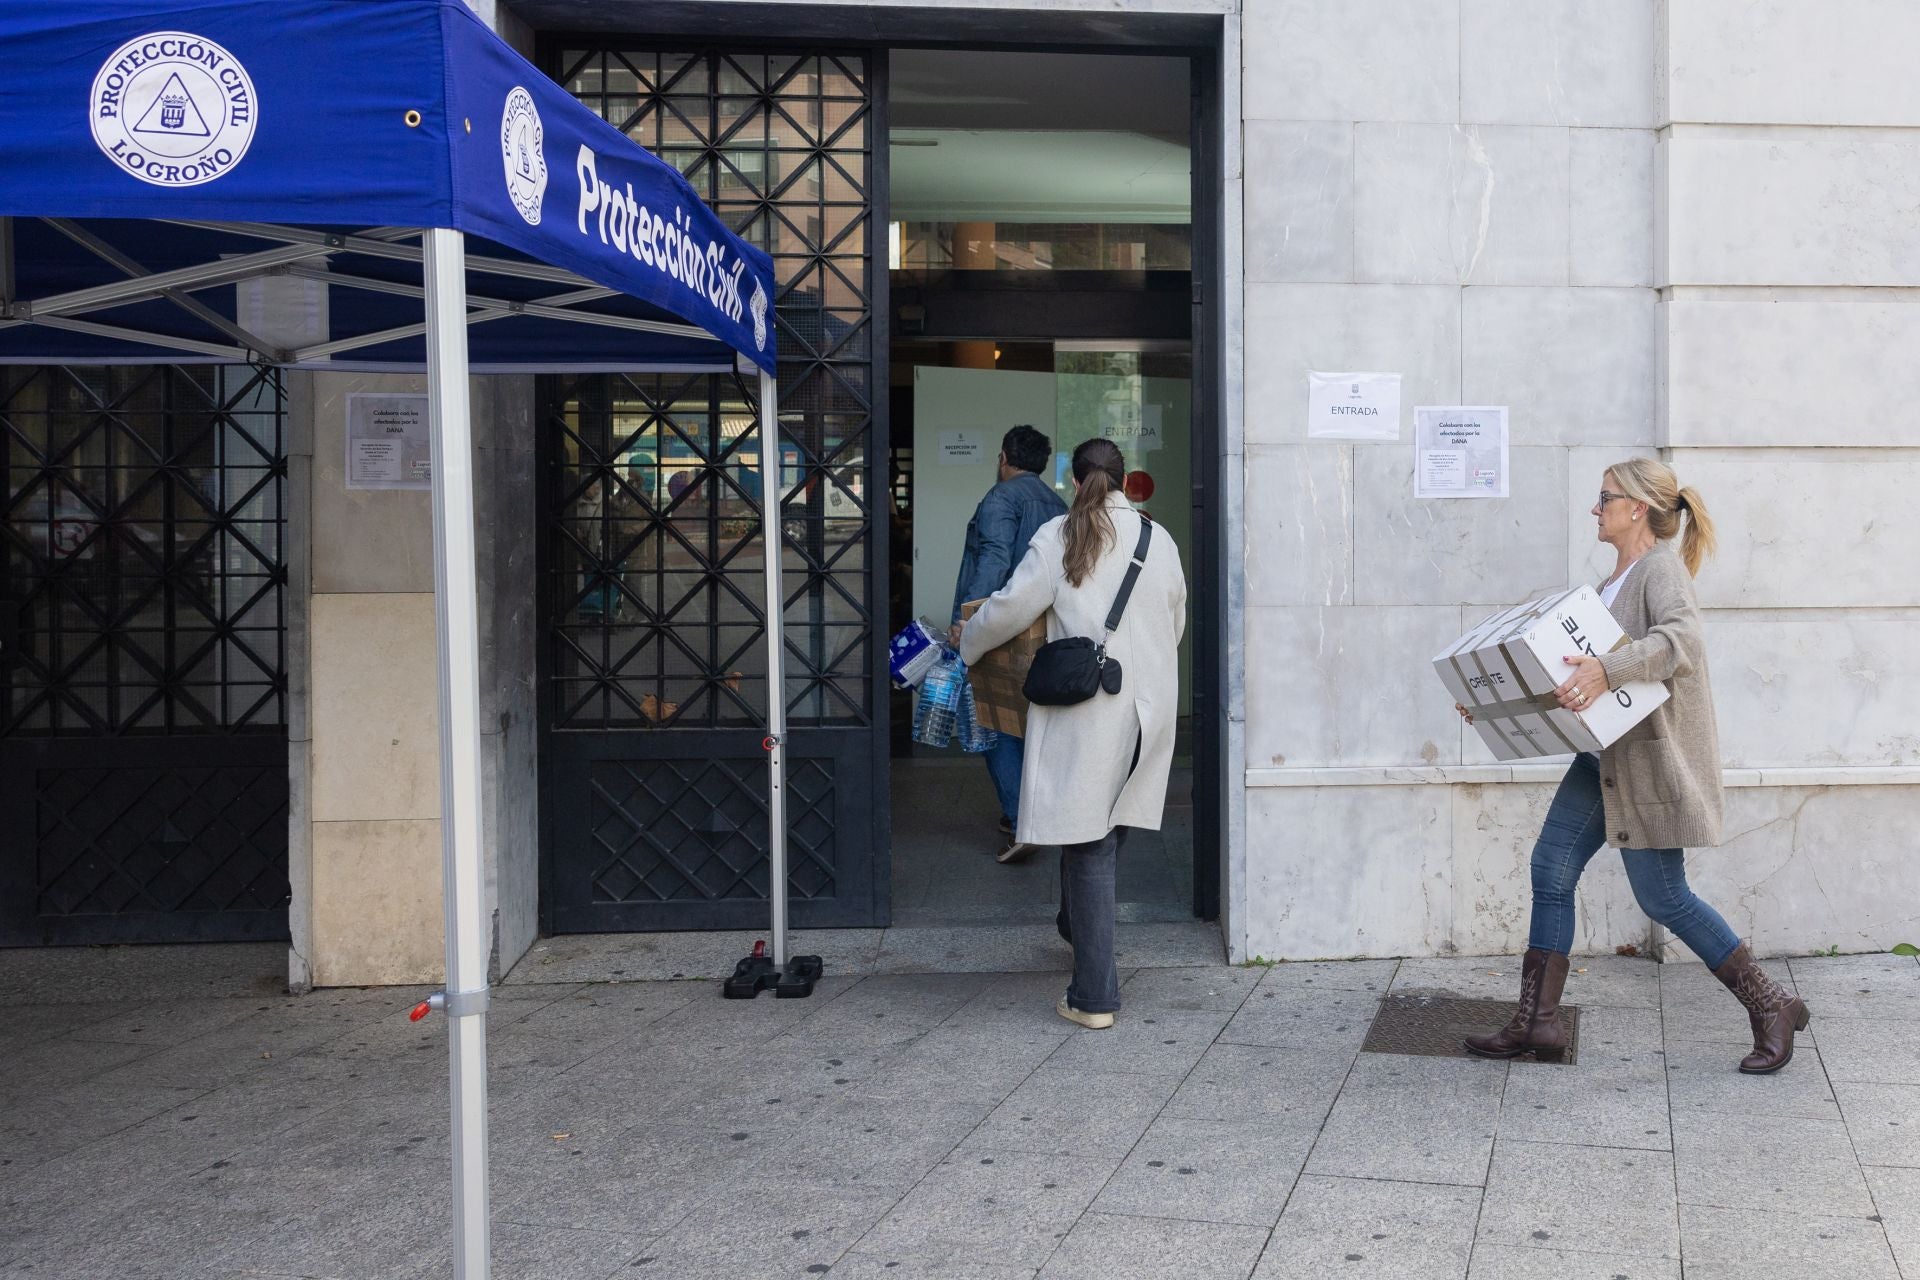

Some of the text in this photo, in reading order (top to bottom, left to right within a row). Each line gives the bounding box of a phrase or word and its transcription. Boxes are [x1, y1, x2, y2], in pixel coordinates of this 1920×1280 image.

[100, 39, 249, 127] PROTECCIÓN CIVIL
[109, 138, 233, 182] LOGROÑO
[576, 143, 706, 298] Protección
[706, 240, 746, 323] Civil
[1105, 427, 1156, 437] ENTRADA
[1331, 406, 1378, 416] ENTRADA
